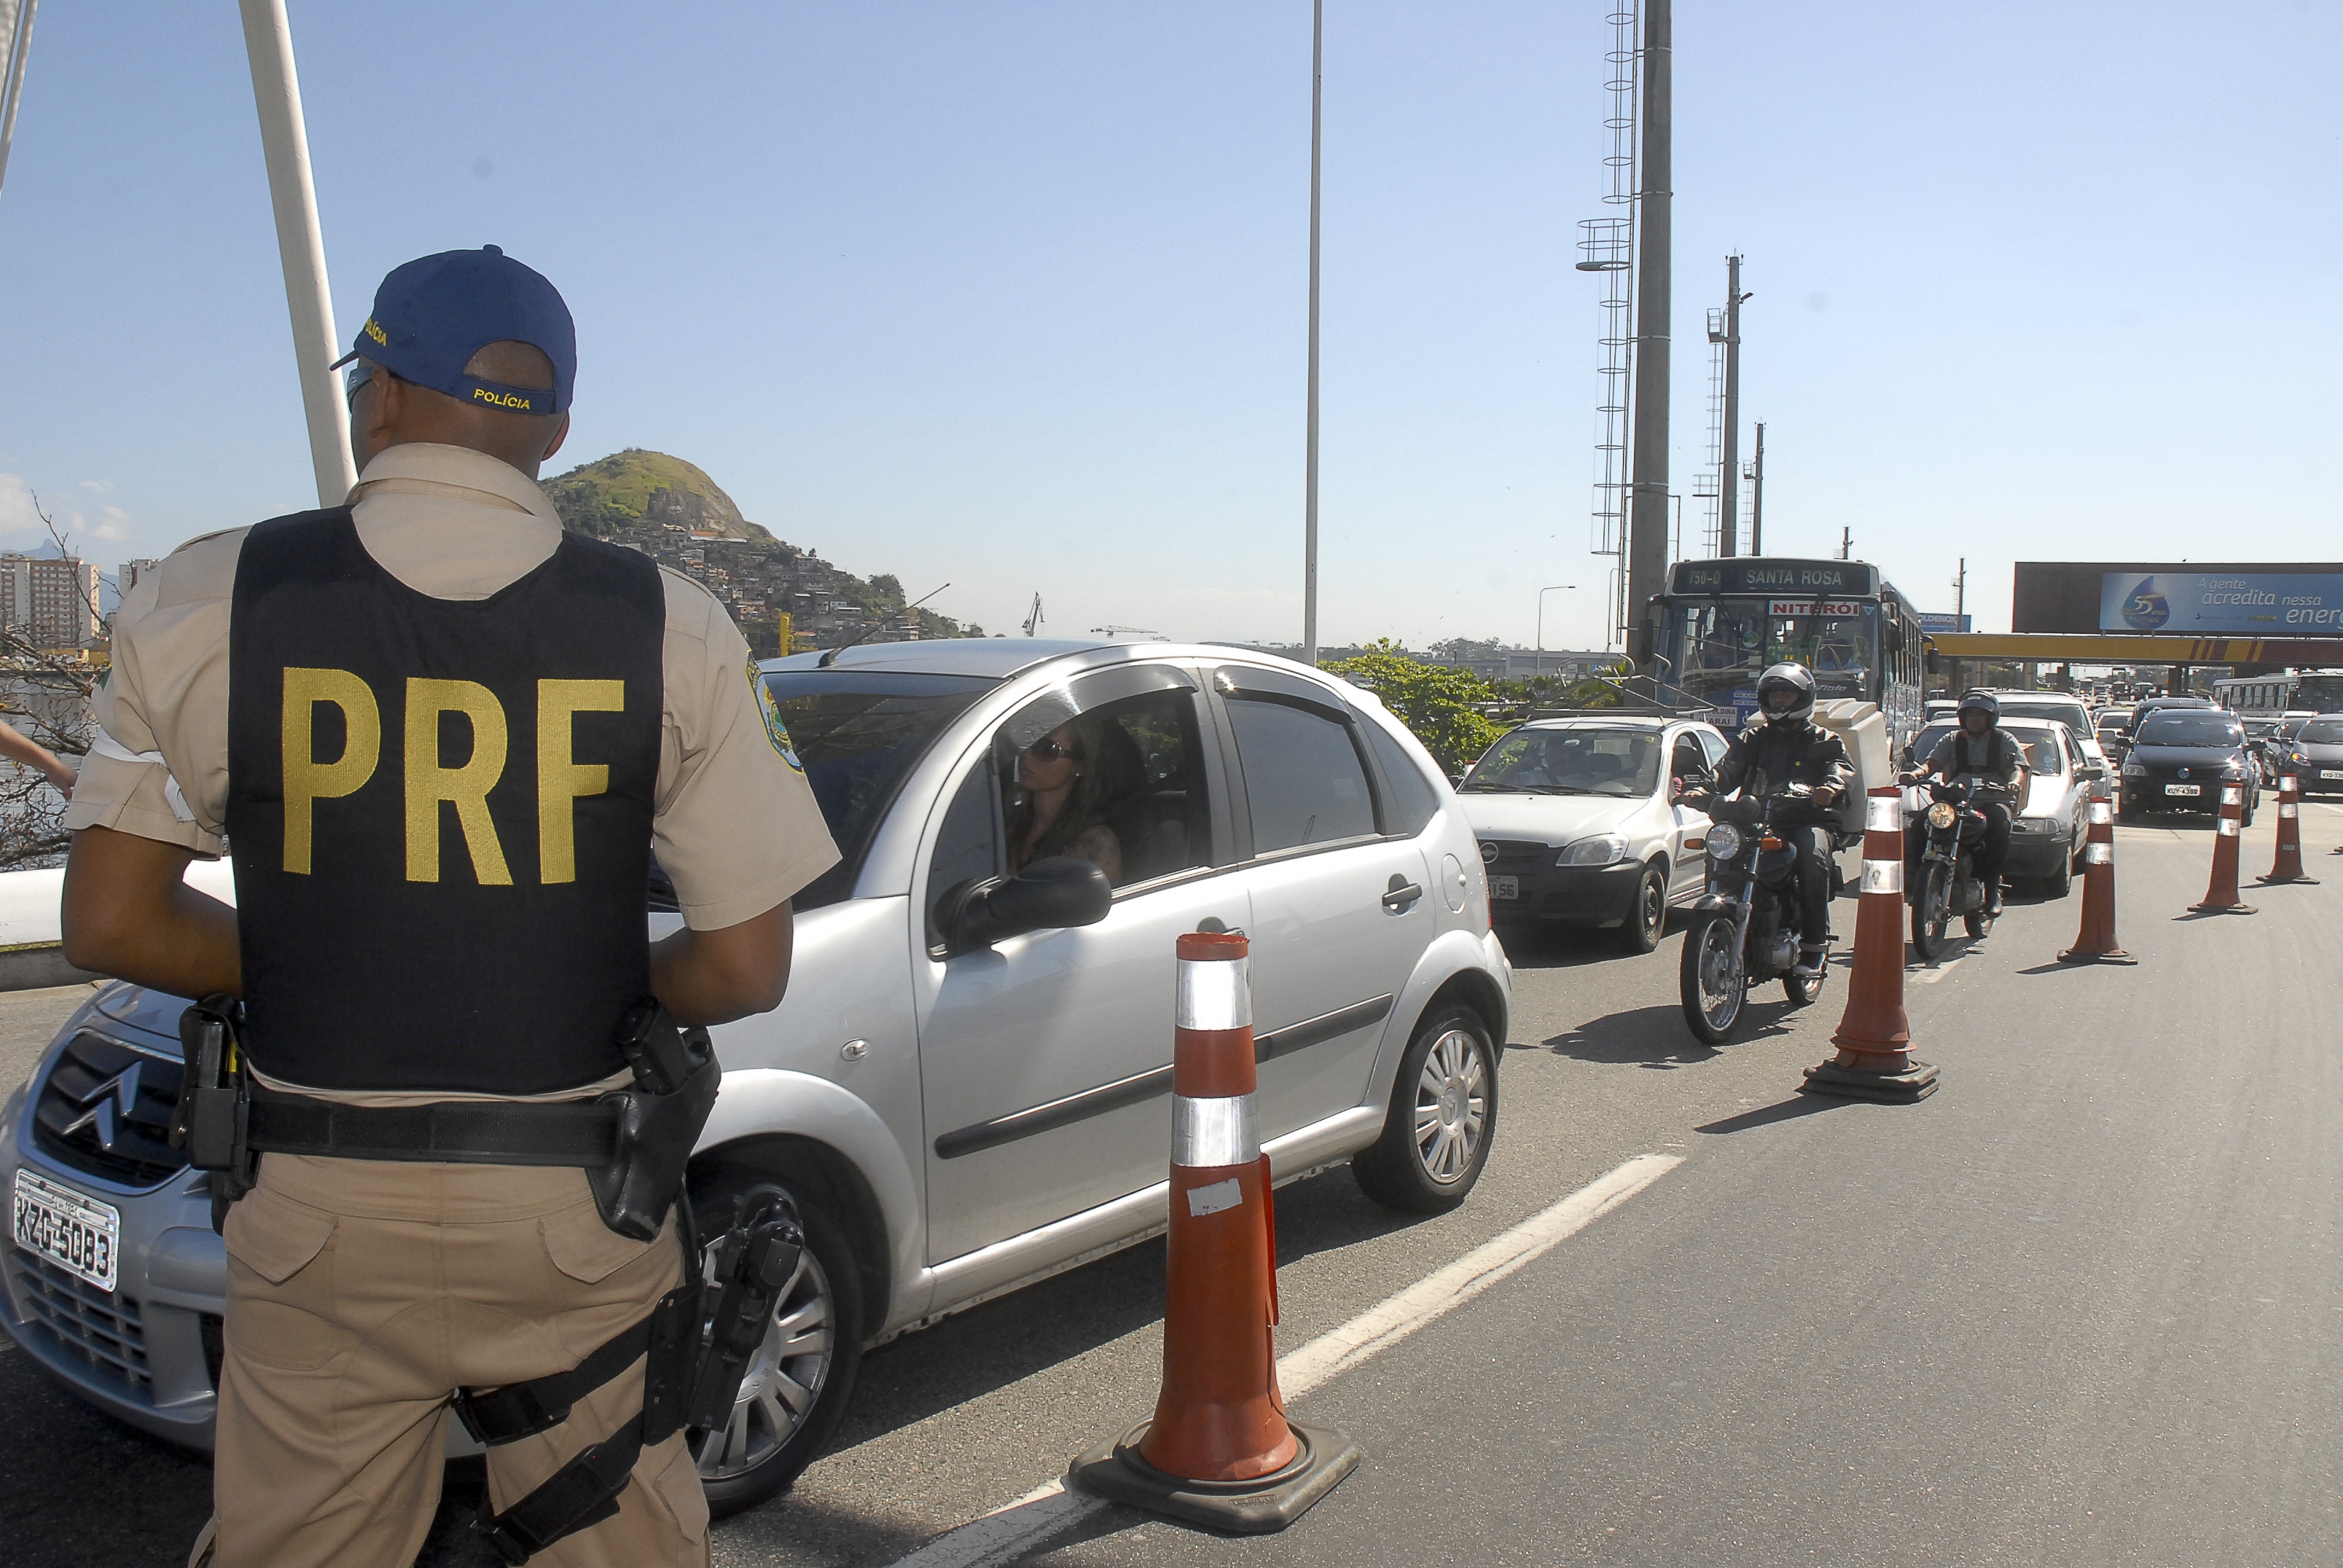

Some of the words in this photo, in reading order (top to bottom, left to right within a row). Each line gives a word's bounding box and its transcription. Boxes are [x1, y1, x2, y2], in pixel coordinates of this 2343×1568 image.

[473, 388, 530, 410] POLÍCIA
[1689, 570, 1721, 585] 750-D
[1746, 569, 1794, 584] SANTA
[1801, 570, 1842, 586] ROSA
[2197, 578, 2206, 589] A
[2209, 579, 2246, 593] gente
[2202, 589, 2276, 605] acredita
[2281, 596, 2323, 606] nessa
[1773, 602, 1859, 615] NITERÓI
[282, 666, 625, 886] PRF
[19, 1198, 112, 1278] KZG-5083
